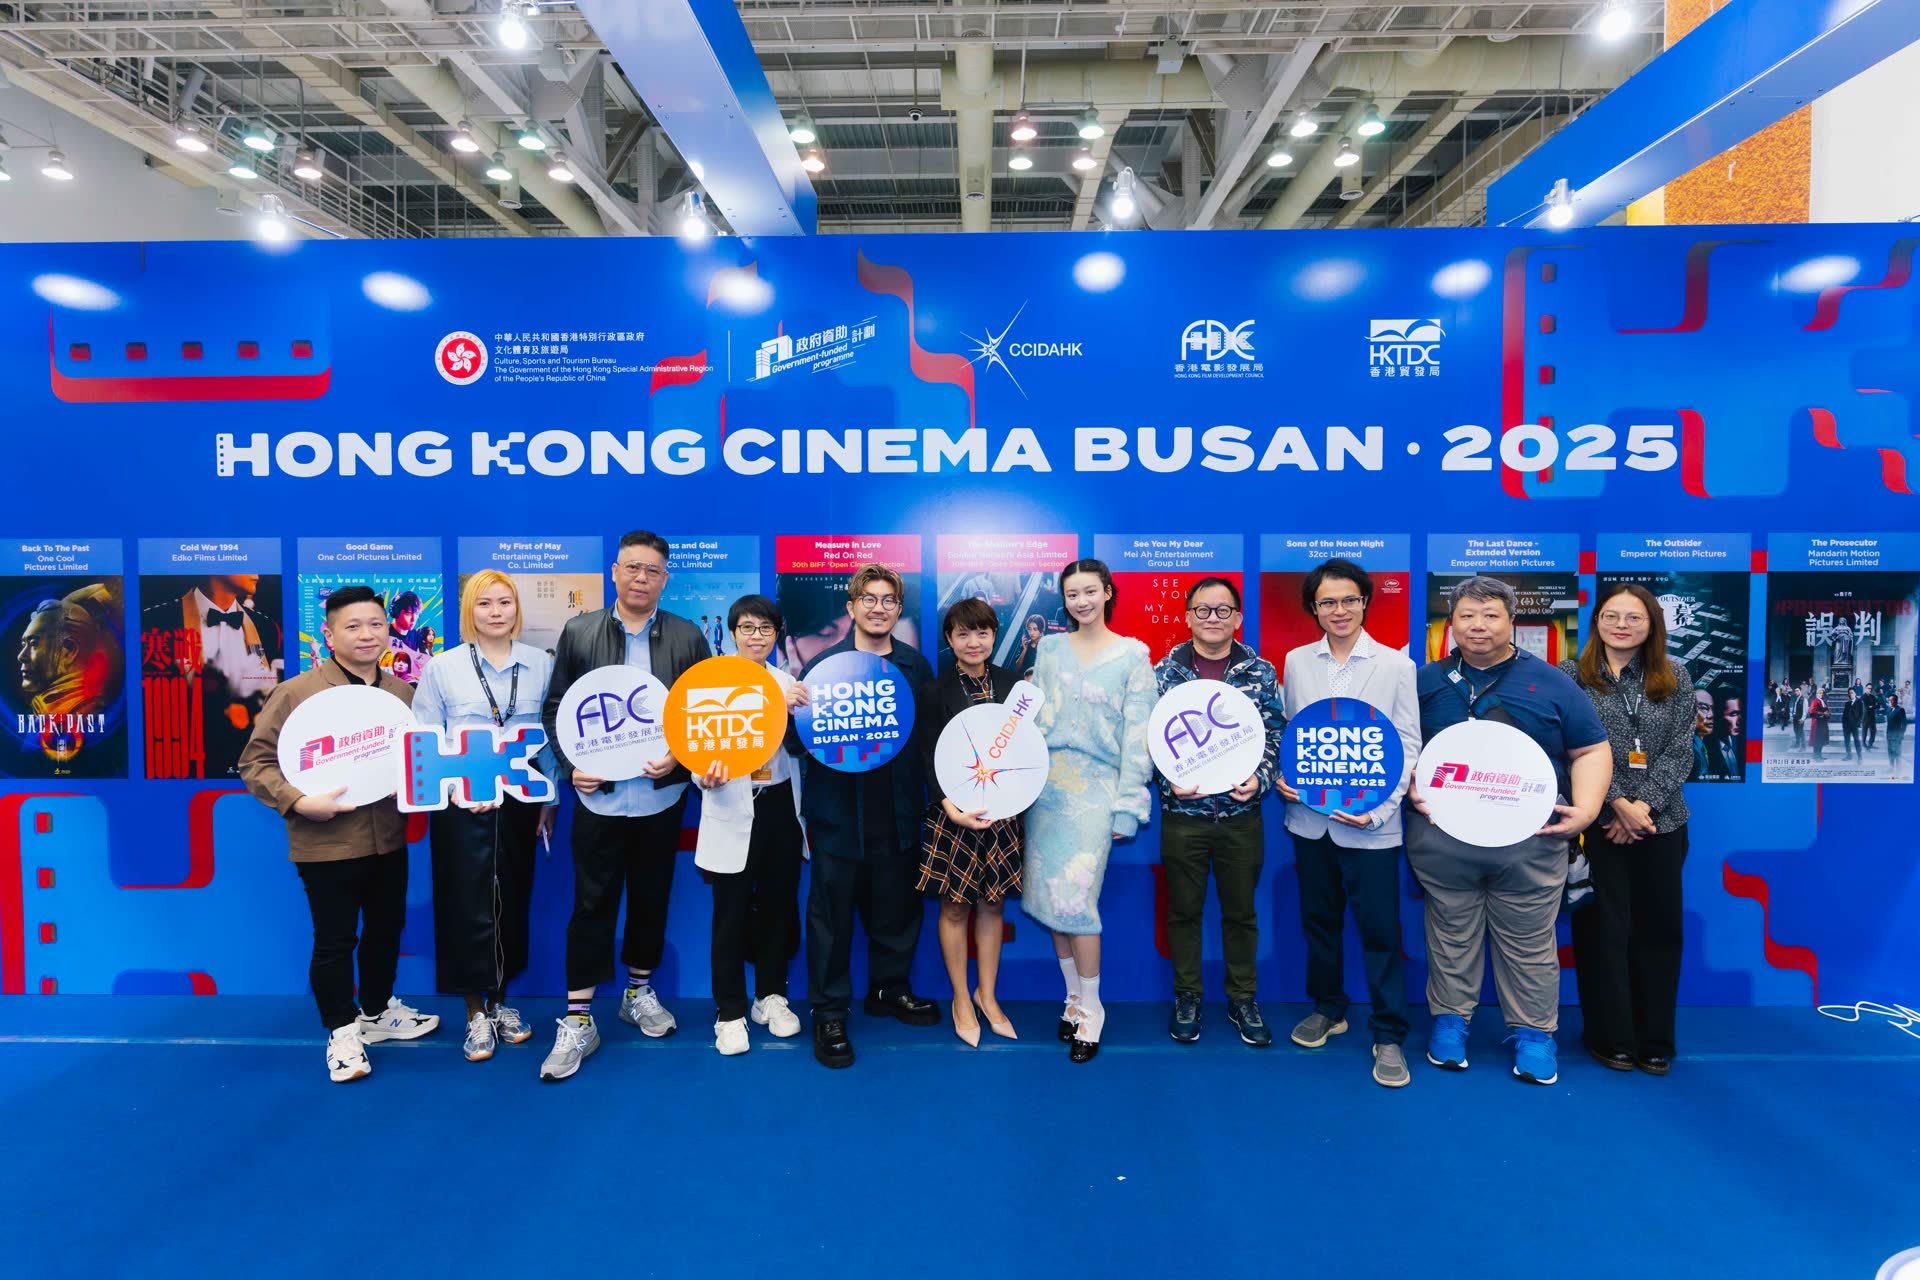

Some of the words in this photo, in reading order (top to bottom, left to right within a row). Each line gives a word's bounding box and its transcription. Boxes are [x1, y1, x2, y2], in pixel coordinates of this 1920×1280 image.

[851, 323, 876, 343] 計劃
[796, 324, 848, 353] 政府資助
[1008, 341, 1083, 357] CCIDAHK
[772, 343, 848, 374] Government-funded
[1370, 344, 1441, 366] HKTDC
[494, 357, 522, 365] Culture,
[522, 357, 546, 367] Sports
[562, 356, 590, 364] Tourism
[591, 356, 617, 364] Bureau
[812, 351, 854, 370] programme
[508, 366, 551, 374] Government
[572, 366, 592, 375] Hong
[593, 366, 611, 375] Kong
[613, 366, 638, 375] Special
[639, 365, 688, 373] Administrative
[689, 365, 714, 375] Region
[1174, 363, 1264, 372] 香港電影發展局
[1370, 365, 1440, 377] 香港貿發局
[515, 375, 545, 384] People's
[546, 375, 576, 384] Republic
[586, 374, 606, 382] China
[216, 430, 452, 477] HONG
[471, 429, 706, 476] KONG
[723, 427, 1052, 476] CINEMA
[1074, 425, 1383, 473] BUSAN
[1441, 424, 1678, 472] 2025
[180, 543, 199, 551] Cold
[201, 543, 217, 551] War
[219, 543, 239, 551] 1994
[345, 543, 368, 551] Good
[369, 543, 393, 551] Game
[499, 542, 512, 552] My
[513, 542, 533, 550] First
[534, 542, 543, 550] of
[544, 542, 561, 552] May
[681, 541, 697, 549] and
[699, 541, 718, 549] Goal
[861, 541, 881, 549] Love
[1026, 541, 1048, 549] Edge
[1133, 540, 1149, 548] See
[1150, 540, 1167, 548] You
[1168, 540, 1182, 549] My
[1183, 540, 1204, 548] Dear
[1286, 540, 1307, 548] Sons
[1308, 539, 1318, 547] of
[1319, 539, 1333, 547] the
[1335, 539, 1358, 547] Neon
[1359, 539, 1384, 549] Night
[1467, 539, 1482, 547] The
[1485, 539, 1505, 547] Last
[1506, 539, 1532, 547] Dance
[1645, 539, 1662, 547] The
[1663, 539, 1702, 547] Outsider
[1811, 538, 1825, 546] The
[1829, 538, 1877, 546] Prosecutor
[21, 544, 42, 552] Back
[44, 544, 54, 552] To
[55, 544, 71, 552] The
[71, 544, 90, 552] Past
[1465, 548, 1506, 556] Extended
[1508, 548, 1541, 556] Version
[1808, 549, 1848, 557] Mandarin
[1850, 549, 1880, 557] Motion
[37, 555, 54, 563] One
[55, 554, 75, 562] Cool
[172, 554, 193, 562] Edko
[194, 553, 215, 562] Films
[217, 553, 248, 562] Limited
[317, 553, 334, 561] One
[335, 553, 355, 561] Cool
[357, 553, 390, 561] Pictures
[391, 553, 422, 561] Limited
[492, 553, 543, 562] Entertaining
[1016, 551, 1034, 559] Asia
[1036, 551, 1068, 559] Limited
[1154, 550, 1214, 558] Entertainment
[1308, 550, 1329, 558] 32cc
[1330, 550, 1362, 558] Limited
[1620, 550, 1658, 559] Emperor
[1691, 549, 1727, 557] Pictures
[24, 563, 56, 571] Pictures
[58, 563, 89, 571] Limited
[682, 560, 713, 568] Limited
[1147, 559, 1174, 569] Group
[1175, 559, 1190, 567] Ltd
[1450, 559, 1488, 568] Emperor
[1490, 558, 1518, 567] Motion
[1520, 558, 1555, 567] Pictures
[1809, 558, 1844, 566] Pictures
[1846, 558, 1879, 566] Limited
[1152, 578, 1179, 588] SEE
[1144, 603, 1164, 612] MY
[1805, 610, 1882, 647] 誤判
[811, 679, 896, 700] HONG
[812, 697, 897, 718] KONG
[17, 714, 60, 736] BACK
[66, 713, 105, 734] PAST
[687, 712, 764, 739] HKTDC
[812, 714, 899, 732] CINEMA
[989, 693, 1034, 759] CCIDAHK
[338, 725, 385, 749] 政府資助
[813, 733, 859, 744] BUSAN
[866, 730, 899, 741] 2025
[1296, 726, 1384, 744] HONG
[687, 736, 765, 752] 香港貿發局
[315, 739, 385, 766] Government-funded
[353, 745, 391, 761] programme
[1297, 743, 1385, 761] KONG
[1297, 761, 1386, 775] CINEMA
[1297, 777, 1343, 786] BUSAN
[1350, 778, 1386, 787] 2025
[1470, 770, 1522, 786] 政府資助
[1444, 781, 1517, 796] Government-funded
[1521, 781, 1547, 794] 計劃
[1479, 793, 1521, 803] programme
